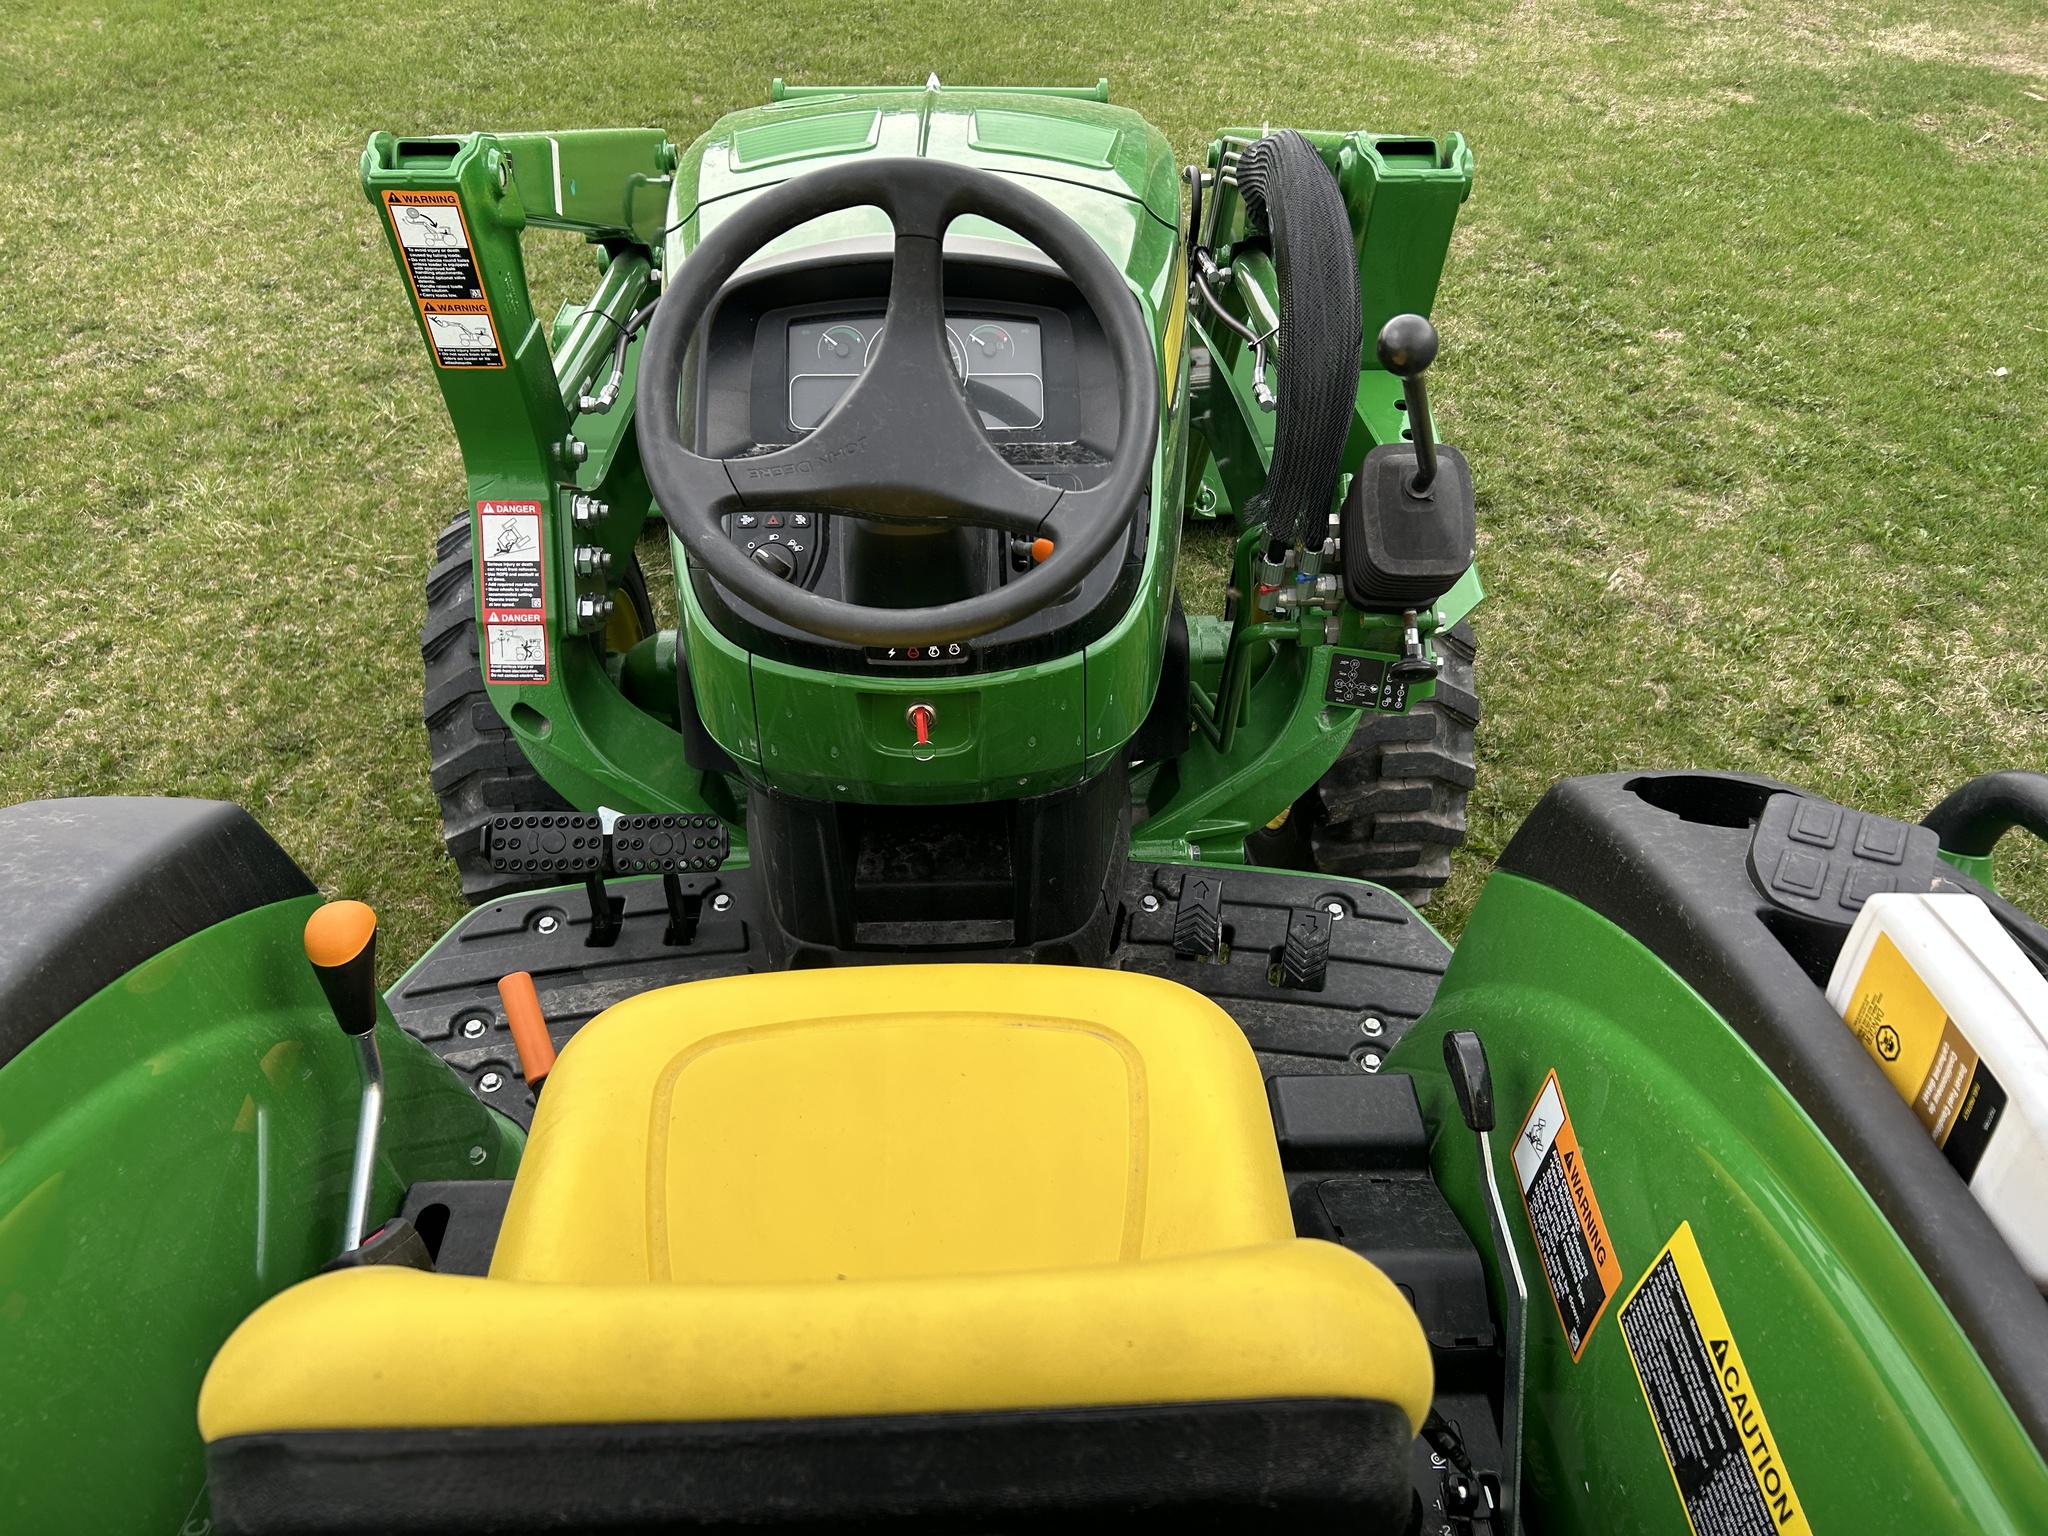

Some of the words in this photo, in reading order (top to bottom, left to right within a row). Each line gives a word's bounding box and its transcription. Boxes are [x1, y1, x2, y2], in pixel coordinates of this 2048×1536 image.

[401, 195, 456, 203] WARNING
[747, 460, 814, 479] DEERE
[1865, 1007, 1885, 1046] DANGER
[1923, 1078, 1936, 1104] diesel
[1930, 1051, 1958, 1104] Conditionneur
[1932, 1042, 1952, 1081] carburant
[1954, 1062, 1968, 1092] Diesel
[1928, 1102, 1936, 1114] de
[1946, 1088, 1959, 1110] Fuel
[1545, 1203, 1553, 1224] seat
[1551, 1223, 1559, 1245] belt.
[1550, 1161, 1559, 1186] Keep
[1558, 1186, 1572, 1225] Rollover
[1570, 1226, 1588, 1276] Protective
[1552, 1150, 1563, 1178] AVOID
[1562, 1178, 1580, 1234] CRUSHING:
[1571, 1166, 1606, 1267] WARNING
[1530, 1204, 1538, 1230] Drive
[1544, 1252, 1552, 1276] extra
[1552, 1277, 1560, 1302] care.
[1533, 1197, 1539, 1213] DO
[1538, 1213, 1546, 1234] NOT
[1550, 1255, 1558, 1276] seat
[1557, 1276, 1565, 1299] belt.
[1535, 1184, 1543, 1212] When
[1542, 1212, 1556, 1254] structure
[1555, 1255, 1565, 1280] must
[1564, 1279, 1569, 1294] be
[1542, 1174, 1548, 1190] Do
[1551, 1207, 1561, 1235] jump
[1560, 1232, 1565, 1240] if
[1563, 1242, 1578, 1283] machine
[1577, 1284, 1585, 1308] tips.
[1546, 1169, 1561, 1212] Structure
[1560, 1212, 1568, 1236] fully
[1567, 1235, 1584, 1285] extended.
[1724, 1366, 1793, 1525] CAUTION
[1739, 1448, 1758, 1490] individual
[1756, 1491, 1769, 1522] brakes
[1768, 1523, 1774, 1533] or
